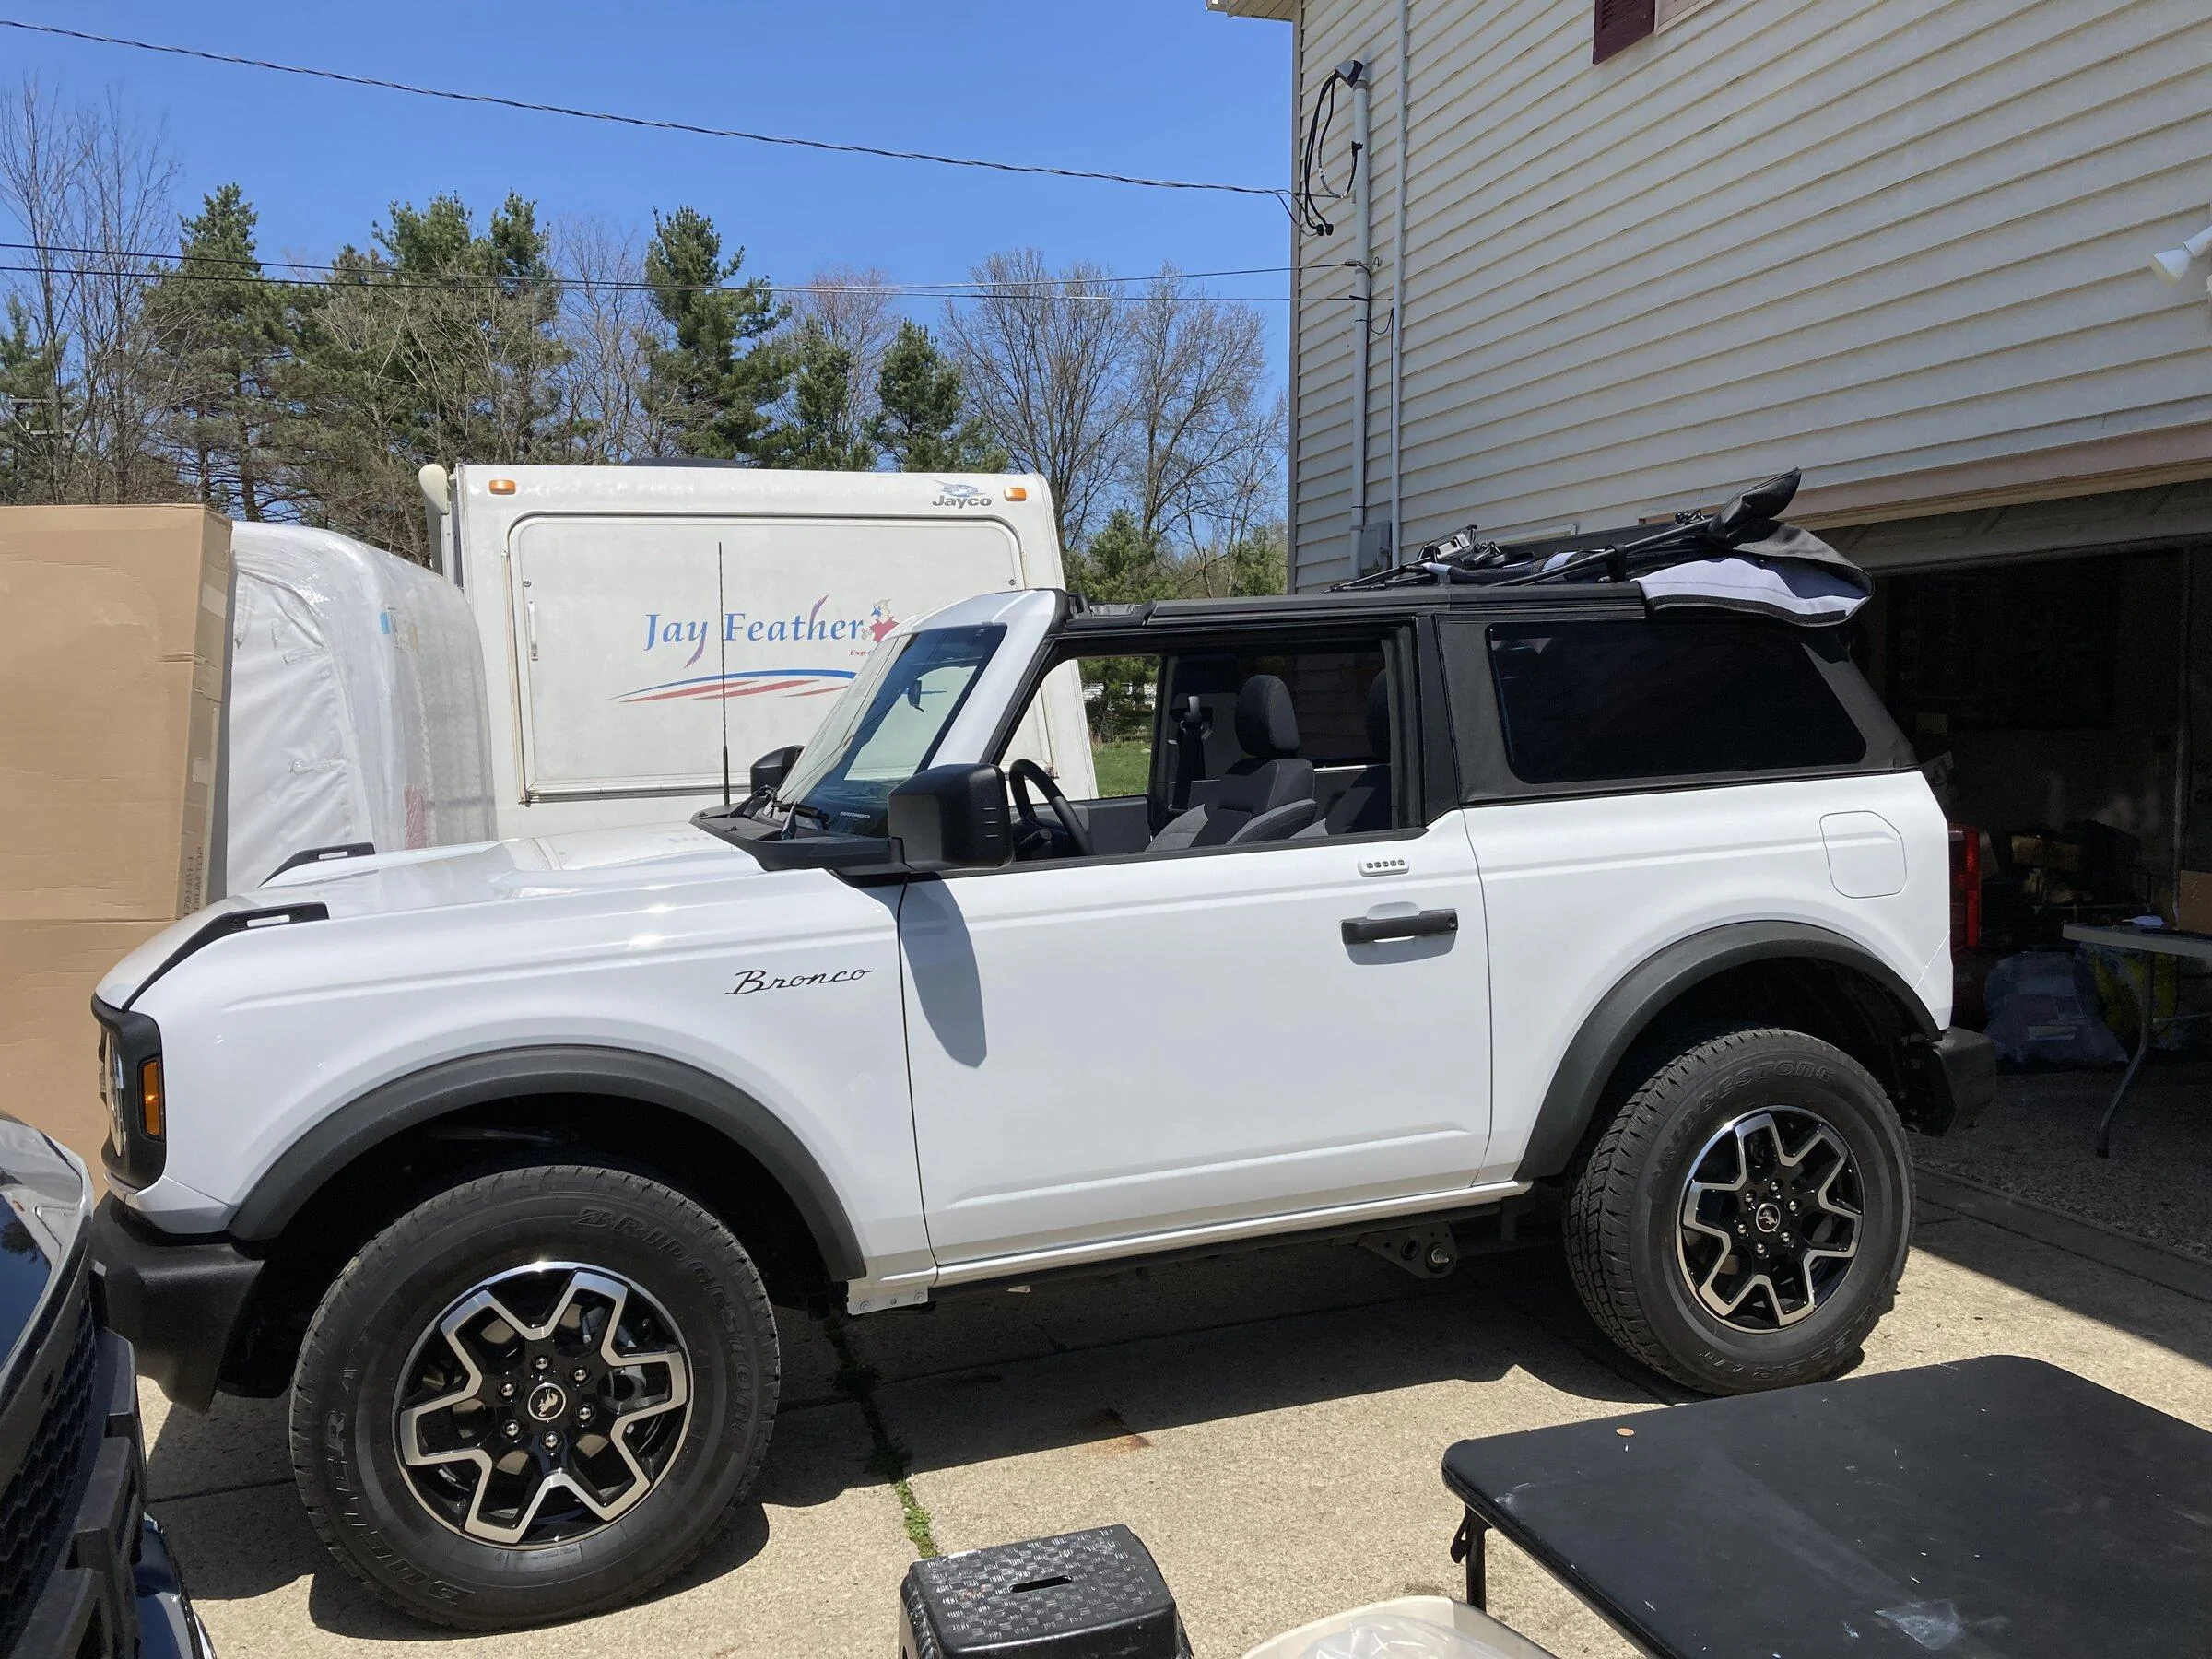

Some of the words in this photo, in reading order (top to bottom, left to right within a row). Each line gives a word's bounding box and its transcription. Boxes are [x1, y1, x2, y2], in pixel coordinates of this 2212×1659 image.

[932, 495, 992, 509] Jayco
[643, 613, 708, 669] Jay
[722, 594, 864, 641] Feather
[725, 969, 873, 995] Bronco
